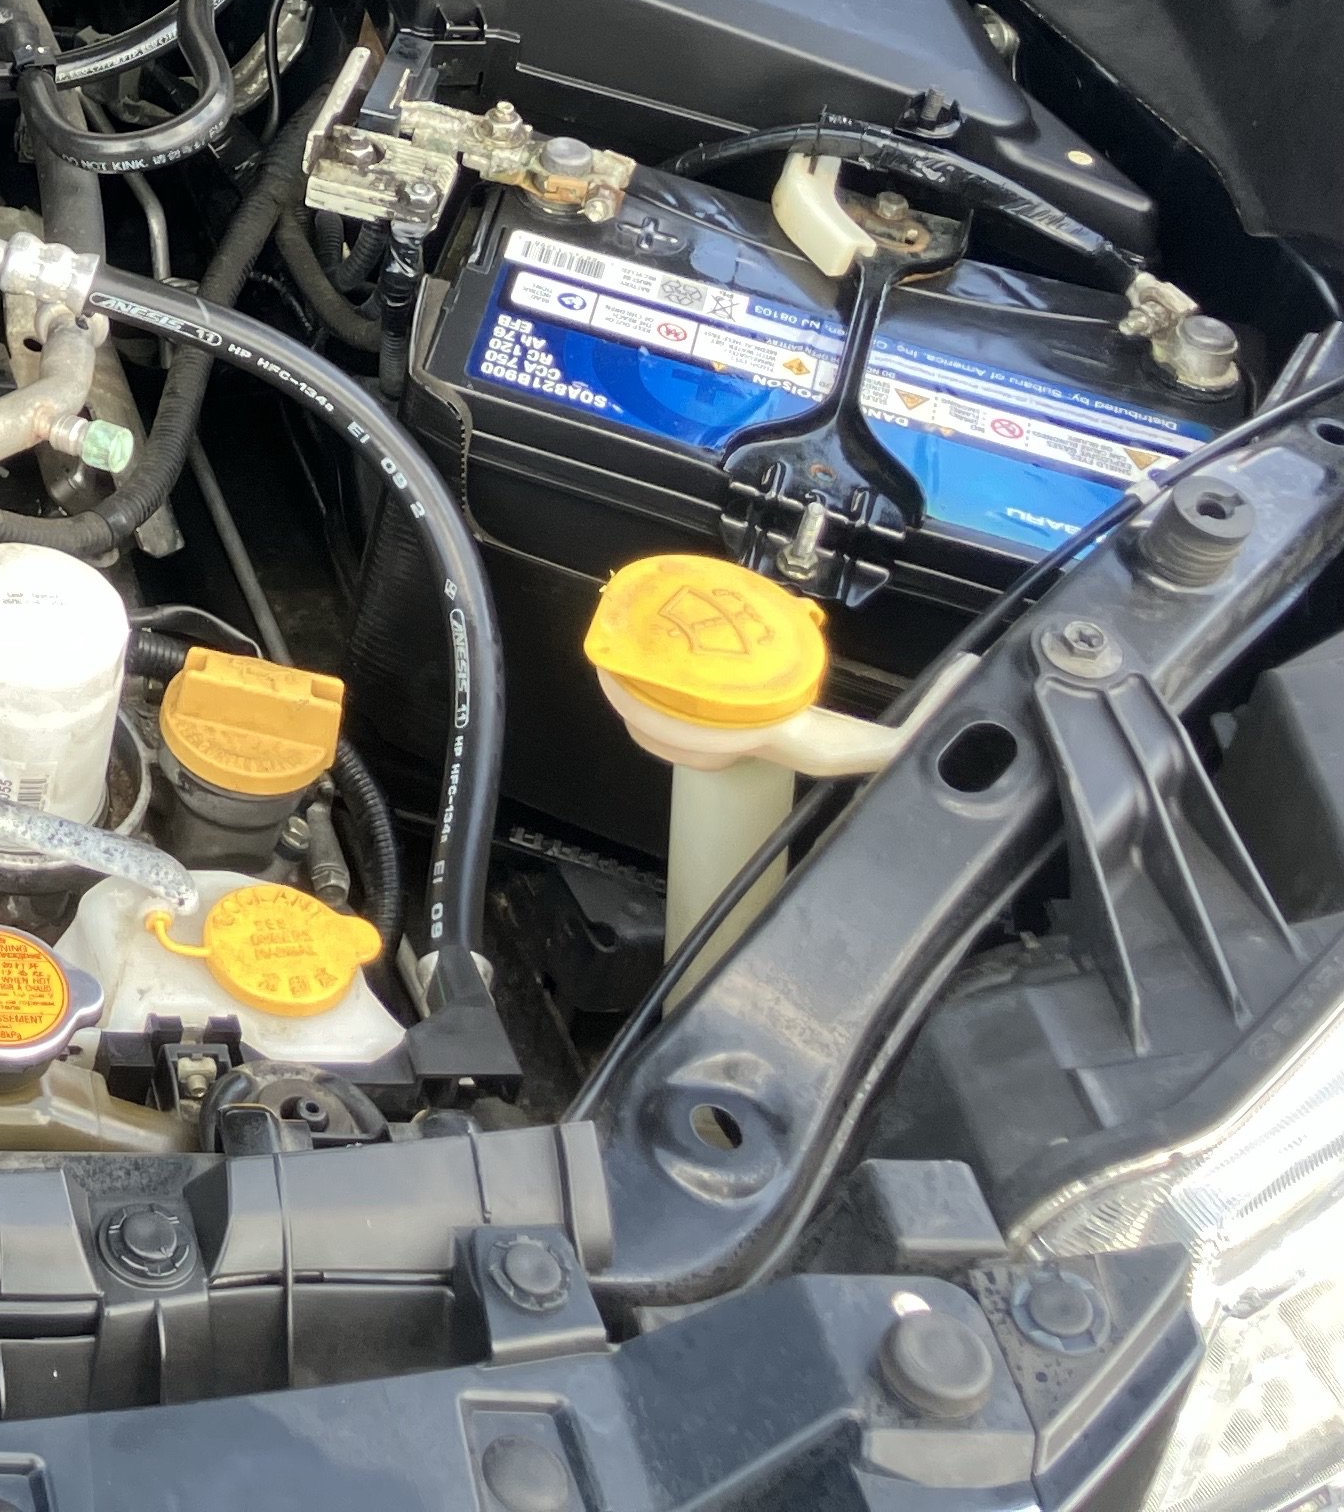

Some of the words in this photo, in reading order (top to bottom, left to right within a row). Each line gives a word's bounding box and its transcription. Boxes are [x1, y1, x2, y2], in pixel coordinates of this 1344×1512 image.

[80, 159, 106, 170] NOT
[496, 312, 533, 334] EFB
[753, 303, 798, 324] 08103
[799, 315, 821, 329] NJ
[492, 324, 516, 341] 76
[518, 332, 546, 350] Ah
[226, 342, 253, 360] HP
[487, 336, 523, 357] 120
[525, 347, 554, 365] RC
[483, 348, 519, 369] 750
[521, 359, 562, 380] CCA
[989, 371, 1005, 383] of
[751, 370, 823, 402] POISON
[1008, 375, 1062, 399] Subaru
[858, 404, 909, 427] DAN
[1093, 399, 1178, 431] Distributed
[451, 735, 465, 757] HP
[1, 976, 28, 984] WHEN
